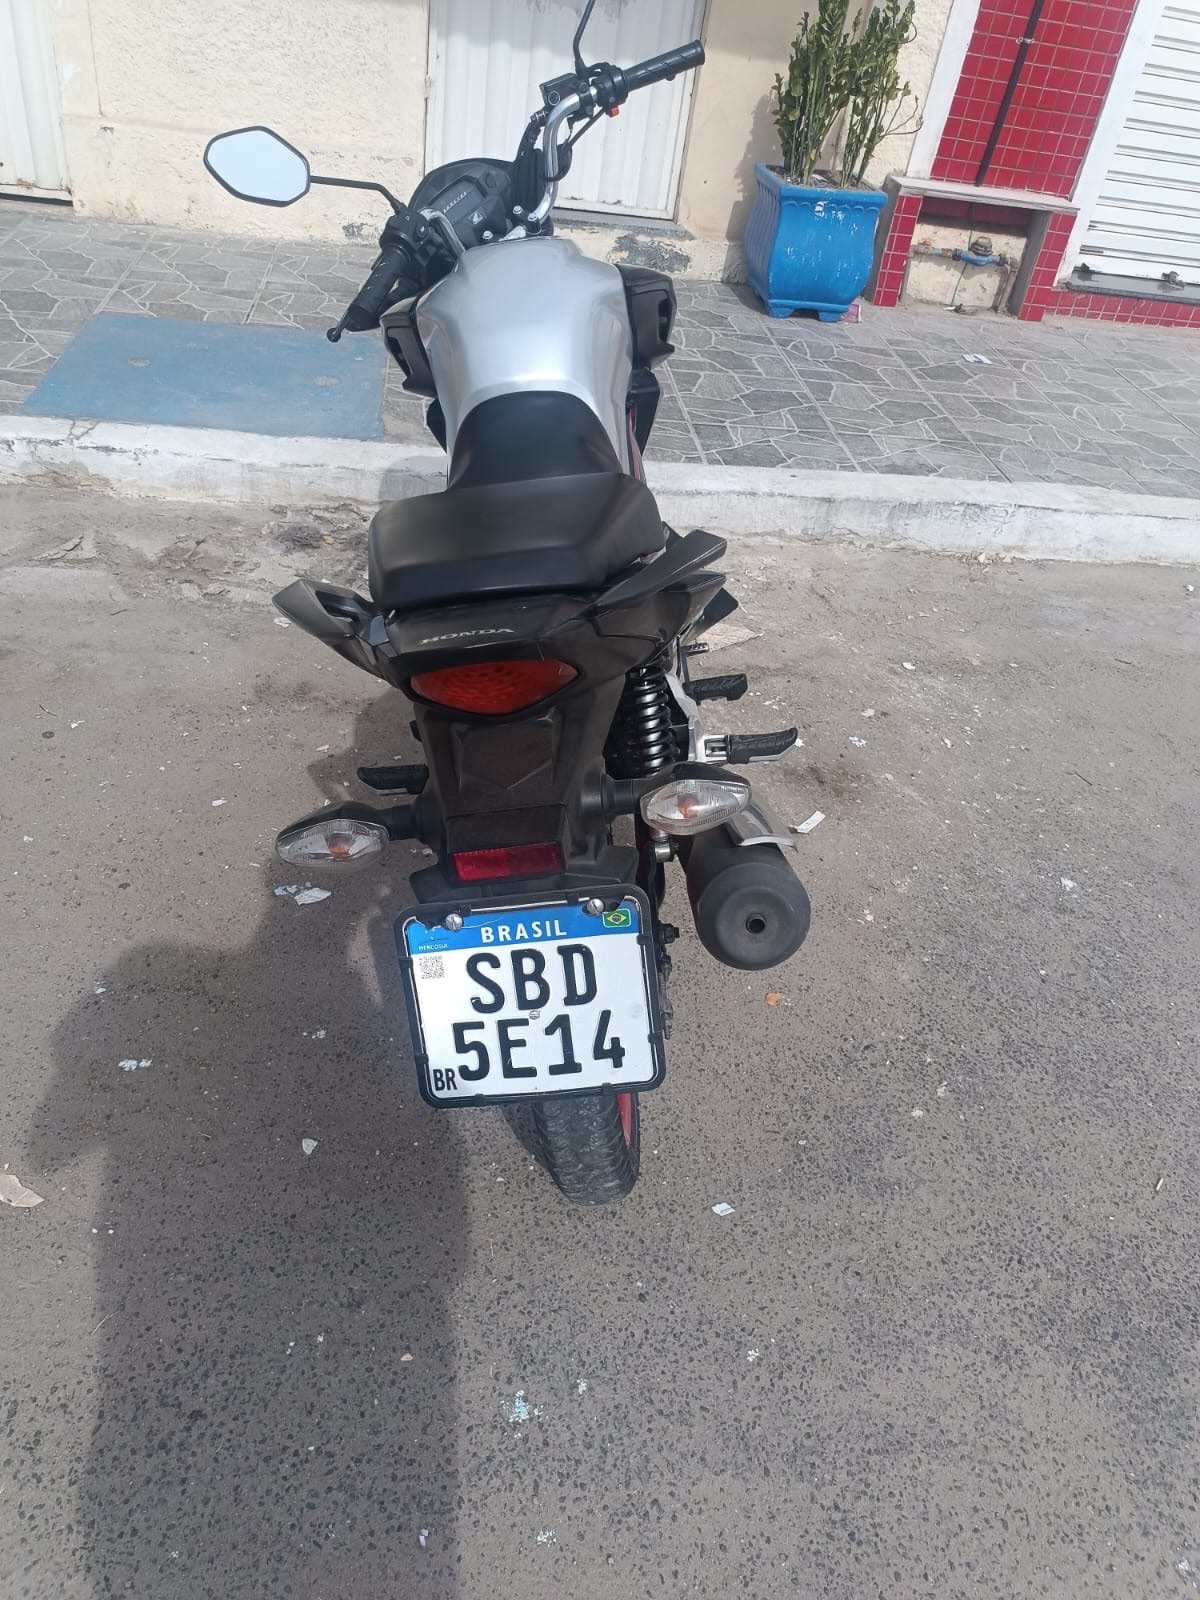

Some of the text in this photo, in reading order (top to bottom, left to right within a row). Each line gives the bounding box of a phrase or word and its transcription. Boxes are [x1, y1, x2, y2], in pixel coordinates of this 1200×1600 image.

[420, 628, 515, 645] HONDA
[480, 919, 567, 943] BRASIL
[466, 943, 598, 1014] SBD
[452, 1009, 626, 1081] 5E14
[432, 1068, 458, 1091] BR
